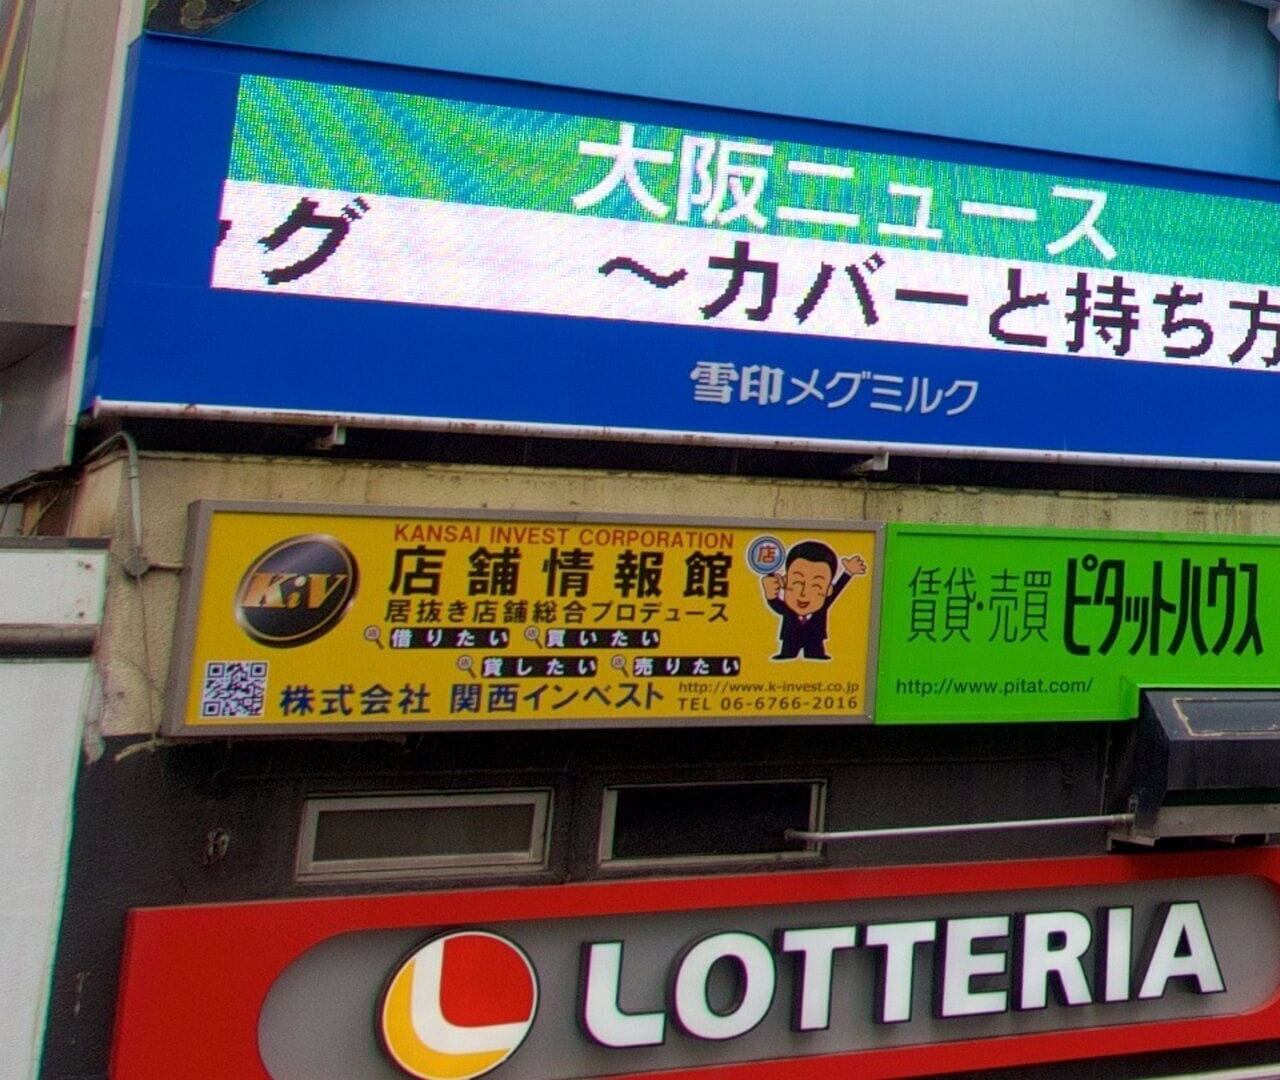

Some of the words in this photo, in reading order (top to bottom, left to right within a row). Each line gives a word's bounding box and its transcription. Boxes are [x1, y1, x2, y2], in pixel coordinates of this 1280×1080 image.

[572, 123, 1117, 261] 大阪ニュース
[690, 360, 979, 416] 雪印メグミルク
[393, 524, 481, 544] KANSAI
[489, 526, 570, 546] INVEST
[579, 528, 734, 549] CORPORATION
[388, 545, 733, 600] 店舗情報館
[384, 599, 729, 624] 居抜き店舗総合プロデュース
[907, 566, 1053, 644] 賃貸・売買
[1062, 552, 1264, 658] ピタットハウス
[391, 628, 509, 648] 借りたい
[546, 628, 660, 648] 買いたい
[482, 657, 597, 677] 貸したい
[634, 656, 740, 677] 売りたい
[279, 683, 431, 717] 株式会社
[449, 681, 664, 713] 関西インベスト
[678, 680, 860, 697] http://www.k-invest.co.jp
[896, 677, 1094, 698] http://www.pitat.com/
[678, 697, 711, 711] TEL
[720, 695, 858, 712] 06-6766-2016
[582, 897, 1229, 1050] LOTTERIA
